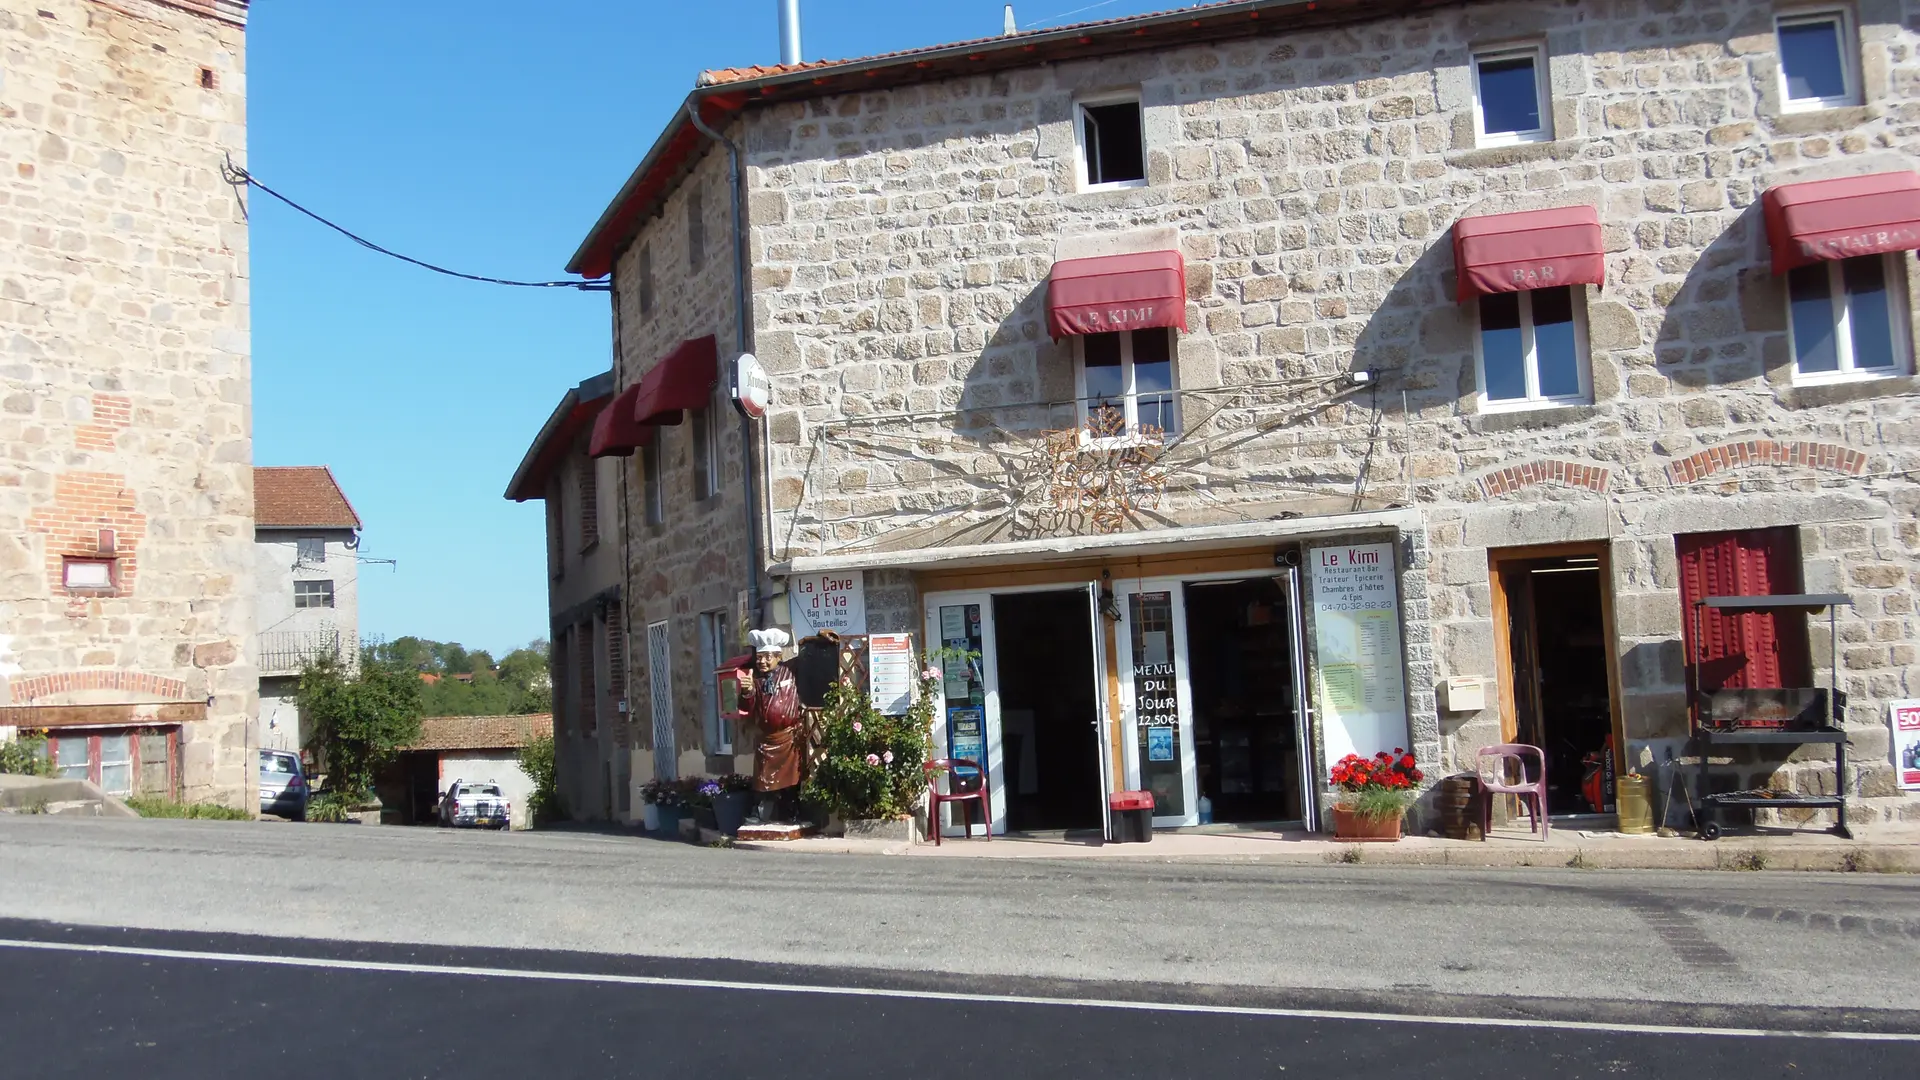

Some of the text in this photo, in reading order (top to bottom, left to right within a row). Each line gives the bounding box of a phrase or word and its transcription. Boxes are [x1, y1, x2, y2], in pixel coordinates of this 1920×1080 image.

[1512, 266, 1555, 283] BAR
[1108, 307, 1153, 323] KIMI
[1322, 549, 1379, 566] Le Kimi
[799, 577, 853, 593] La Cave
[1319, 574, 1384, 584] Traiteur Epicerie
[1322, 583, 1385, 593] Chambres d'hôtes
[1349, 594, 1363, 602] Epis
[1321, 600, 1392, 612] 04-70-32-92-23
[807, 609, 820, 619] Bag
[834, 608, 847, 616] box
[812, 619, 848, 628] Bouteilles
[1134, 664, 1174, 677] MENU
[1144, 680, 1167, 691] DU
[1138, 695, 1176, 710] JOUR
[1138, 714, 1176, 726] 12,50€
